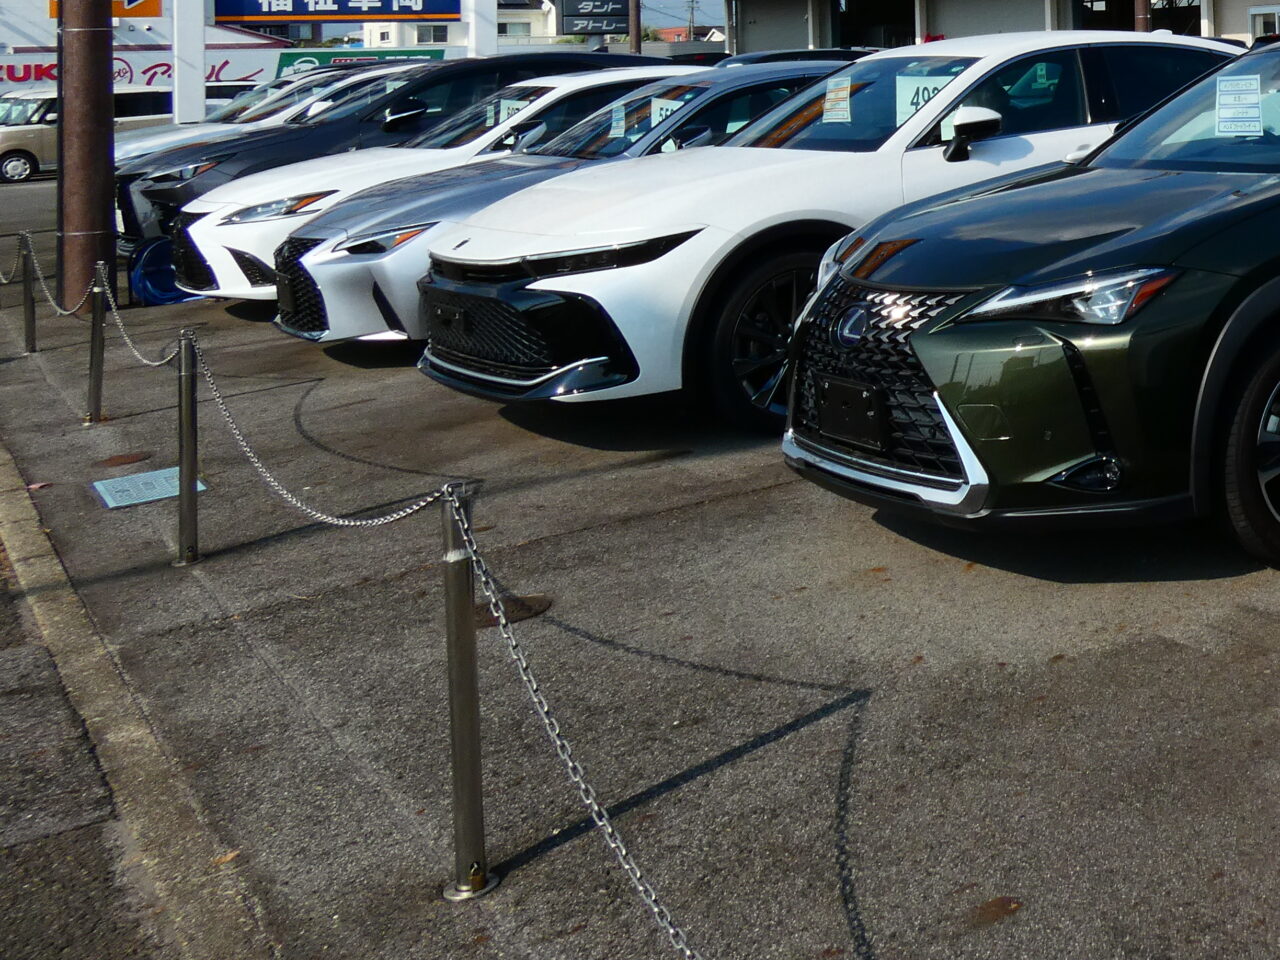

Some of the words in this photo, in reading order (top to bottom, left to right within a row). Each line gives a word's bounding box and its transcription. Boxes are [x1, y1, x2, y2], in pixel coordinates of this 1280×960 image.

[578, 1, 622, 13] タント
[573, 20, 627, 31] アトレー
